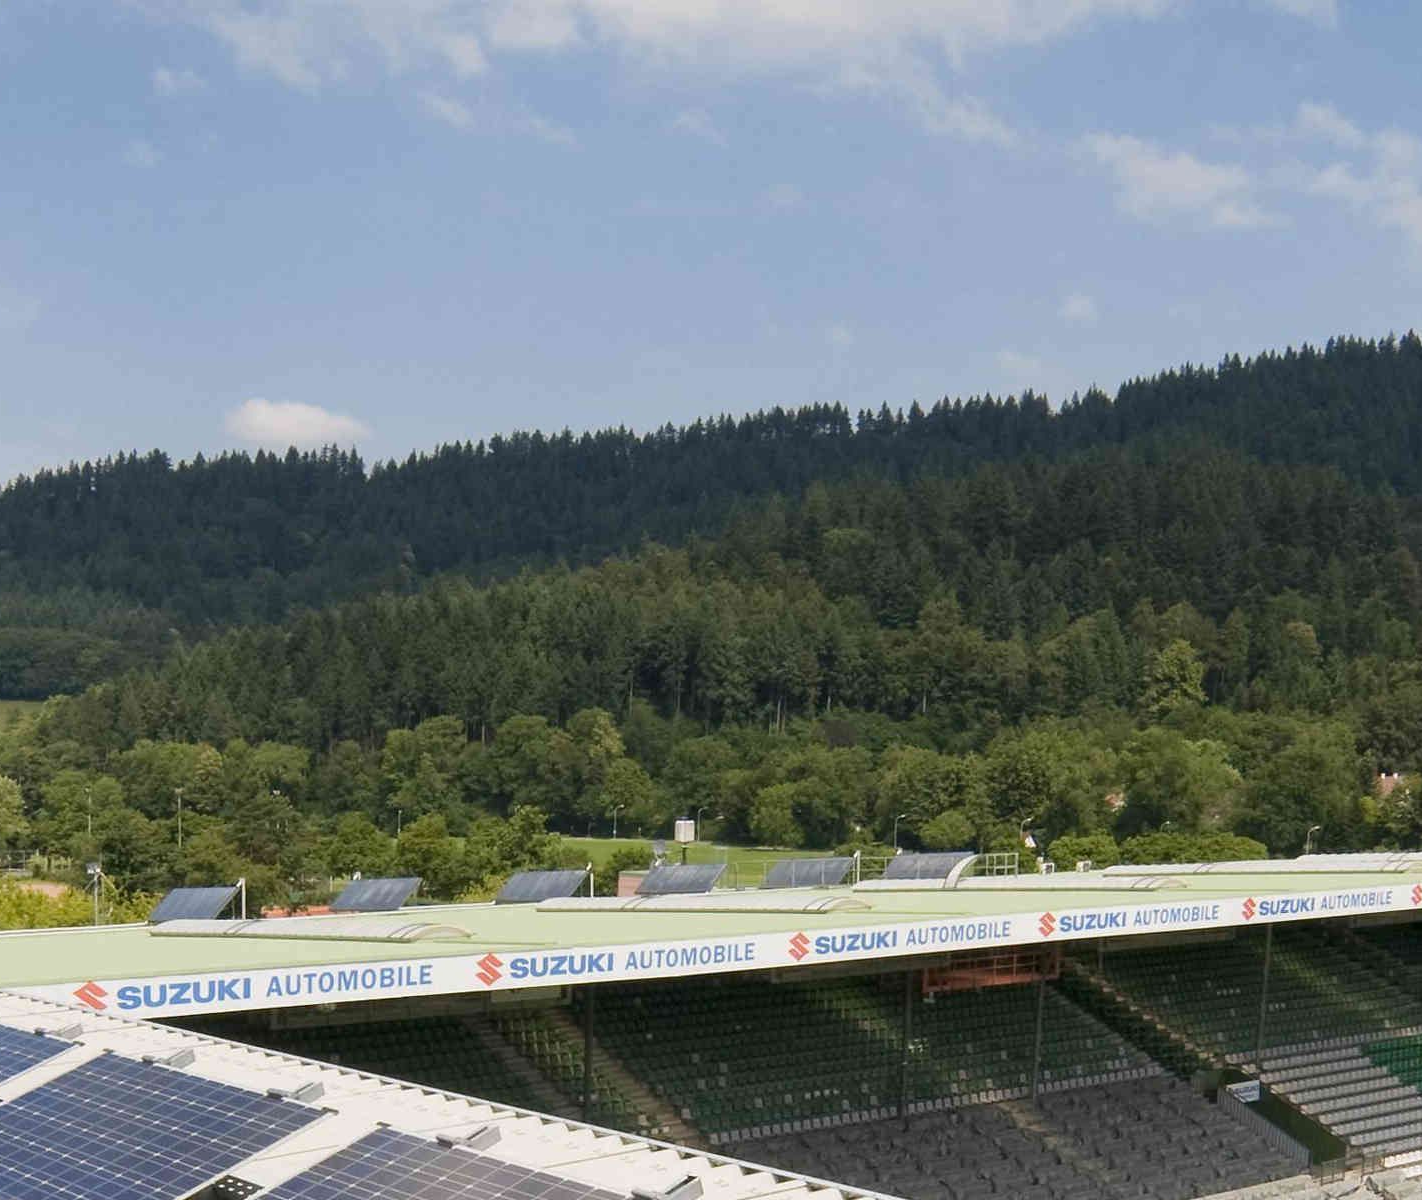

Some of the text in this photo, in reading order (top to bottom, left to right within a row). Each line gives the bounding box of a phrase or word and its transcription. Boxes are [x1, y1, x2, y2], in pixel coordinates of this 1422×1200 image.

[1059, 905, 1219, 932] SUZUKI AUTOMOBILE
[1259, 891, 1393, 916] SUZUKI AUTOMOBILE
[814, 921, 1011, 955] SUZUKI AUTOMOBILE
[509, 942, 755, 980] SUZUKI AUTOMOBILE
[116, 964, 434, 1010] SUZUKI AUTOMOBILE
